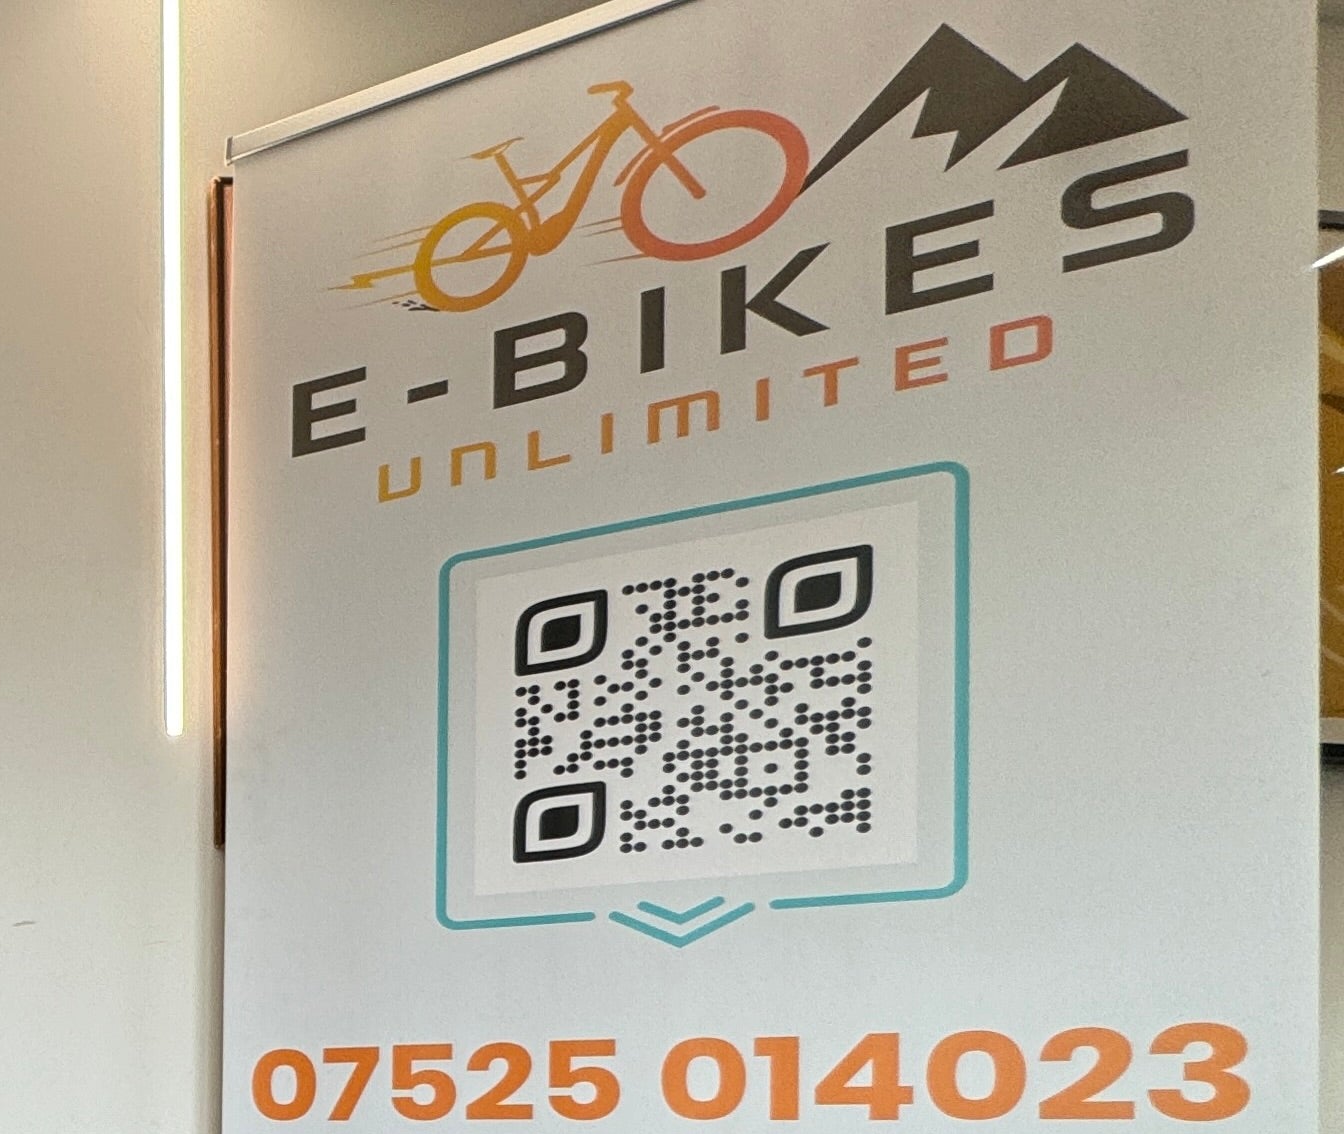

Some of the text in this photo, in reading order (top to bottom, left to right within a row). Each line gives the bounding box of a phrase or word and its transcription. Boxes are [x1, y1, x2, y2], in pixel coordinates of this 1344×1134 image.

[291, 148, 1196, 458] E-BIKES
[377, 315, 1054, 503] UNLIMITED
[250, 1022, 1251, 1122] 07525 014023
